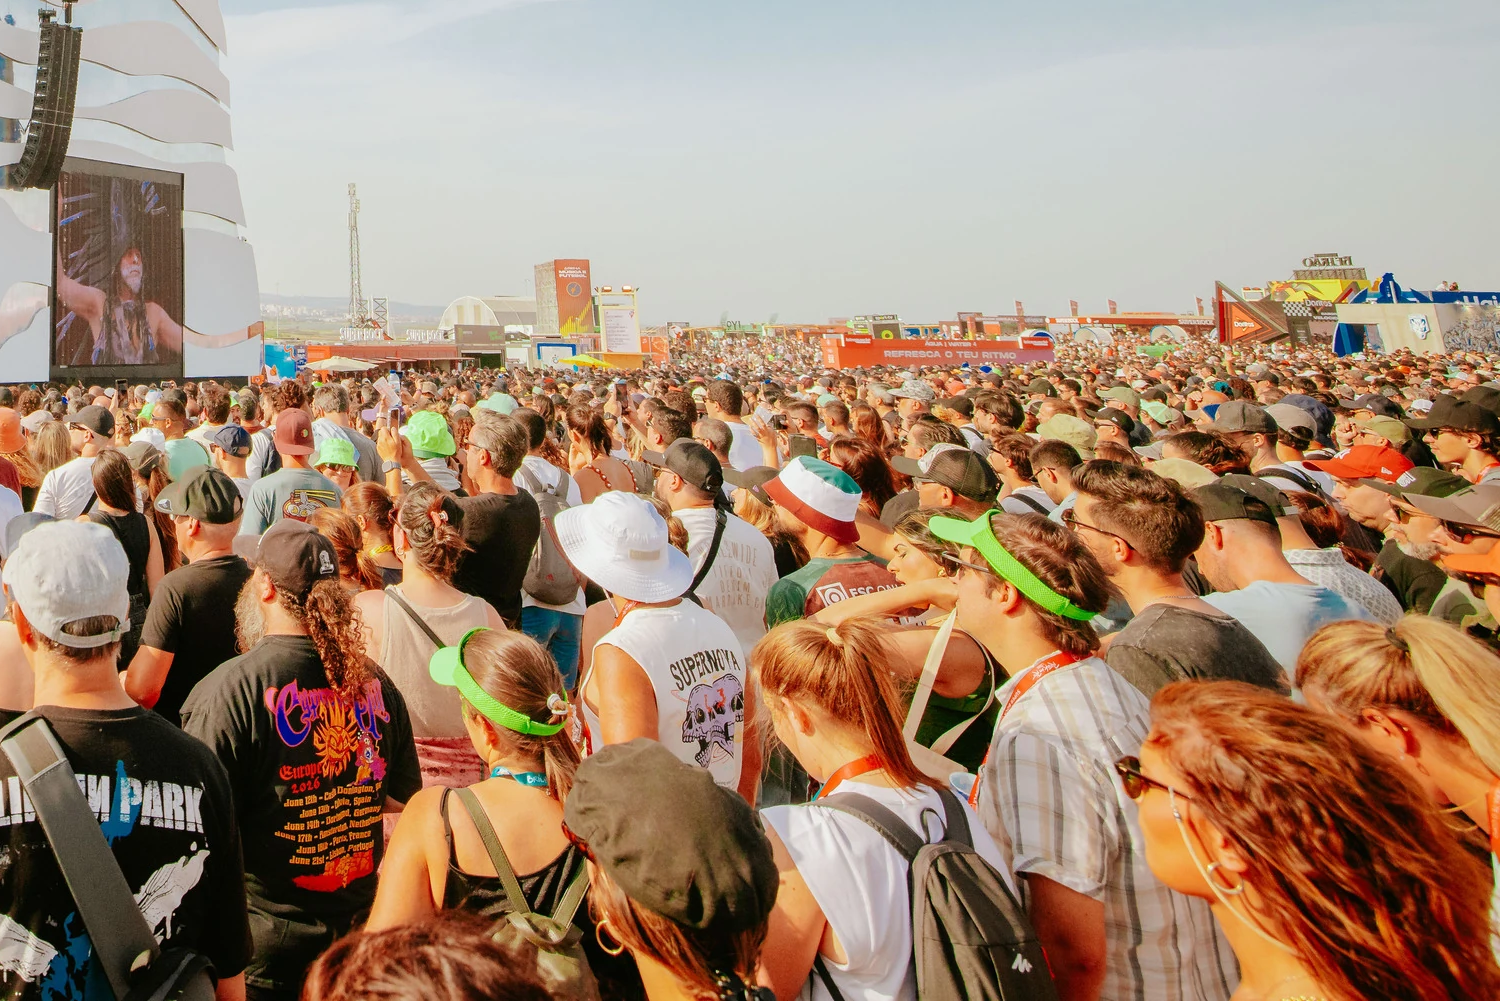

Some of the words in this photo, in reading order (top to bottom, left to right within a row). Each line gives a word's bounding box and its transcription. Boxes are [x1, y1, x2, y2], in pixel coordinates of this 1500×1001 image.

[1305, 299, 1333, 307] Doritos
[884, 350, 940, 359] REFRESCA
[982, 352, 1017, 360] RITMO
[291, 776, 320, 794] 2026
[119, 776, 205, 834] PARK
[284, 799, 304, 807] June
[300, 809, 317, 818] June
[354, 797, 372, 806] Spain
[284, 822, 305, 831] June
[274, 831, 296, 841] June
[298, 833, 312, 842] 17th
[289, 856, 310, 864] June
